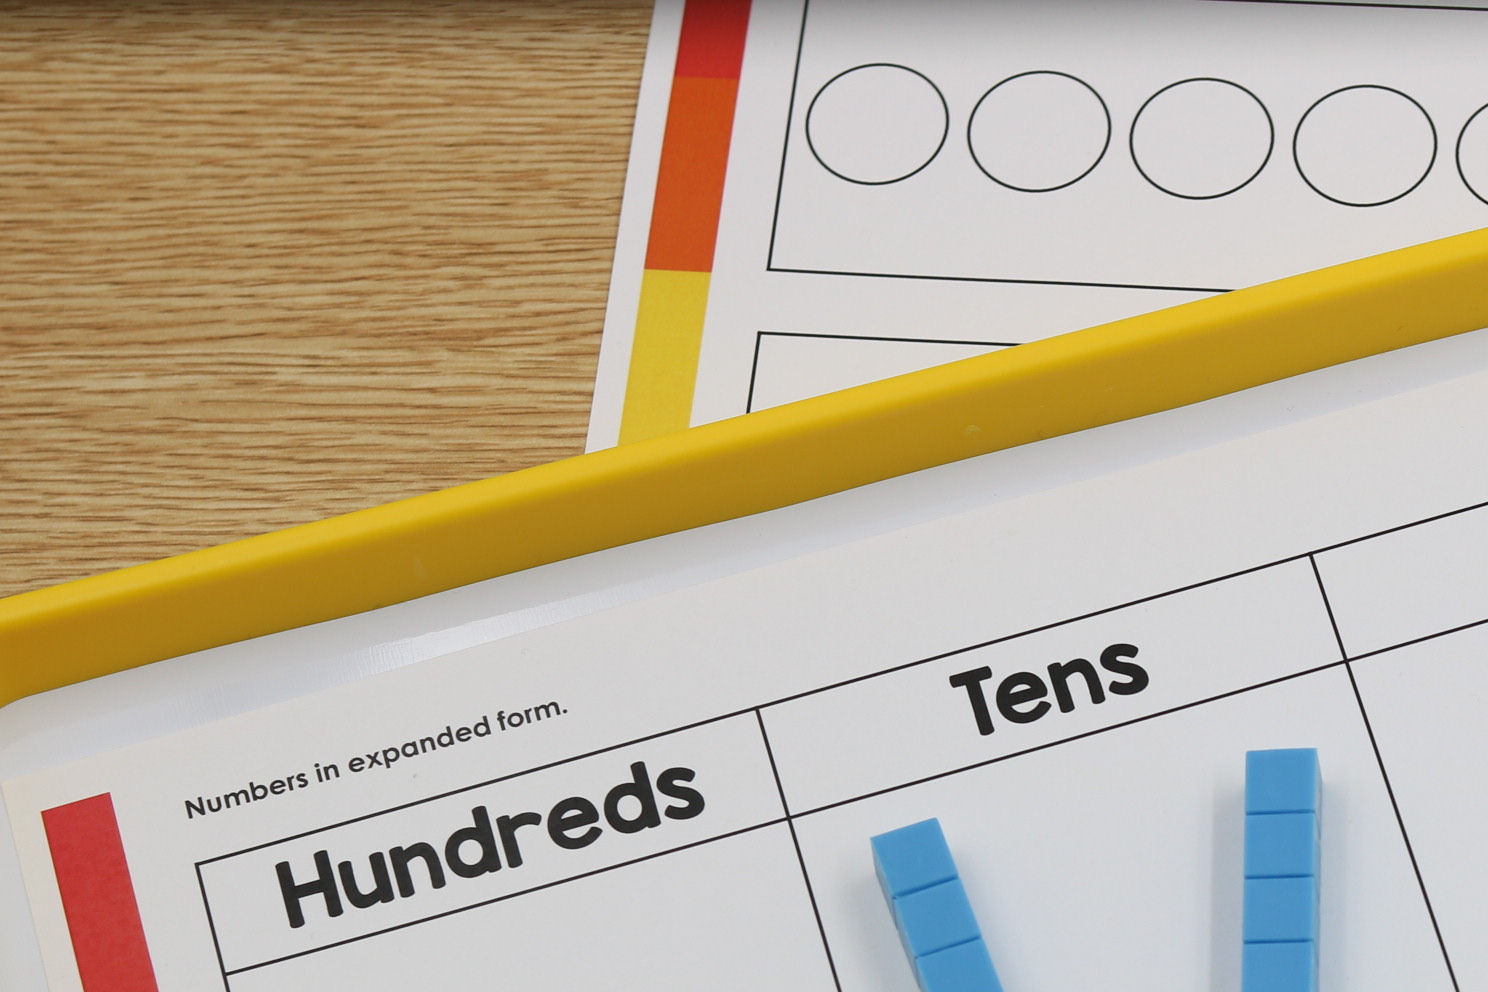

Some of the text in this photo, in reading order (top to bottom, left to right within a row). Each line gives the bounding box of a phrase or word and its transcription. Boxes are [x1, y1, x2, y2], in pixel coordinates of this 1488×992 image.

[948, 642, 1151, 737] Tens
[184, 699, 569, 820] Numbers in expanded form.
[274, 760, 706, 930] Hundreds
